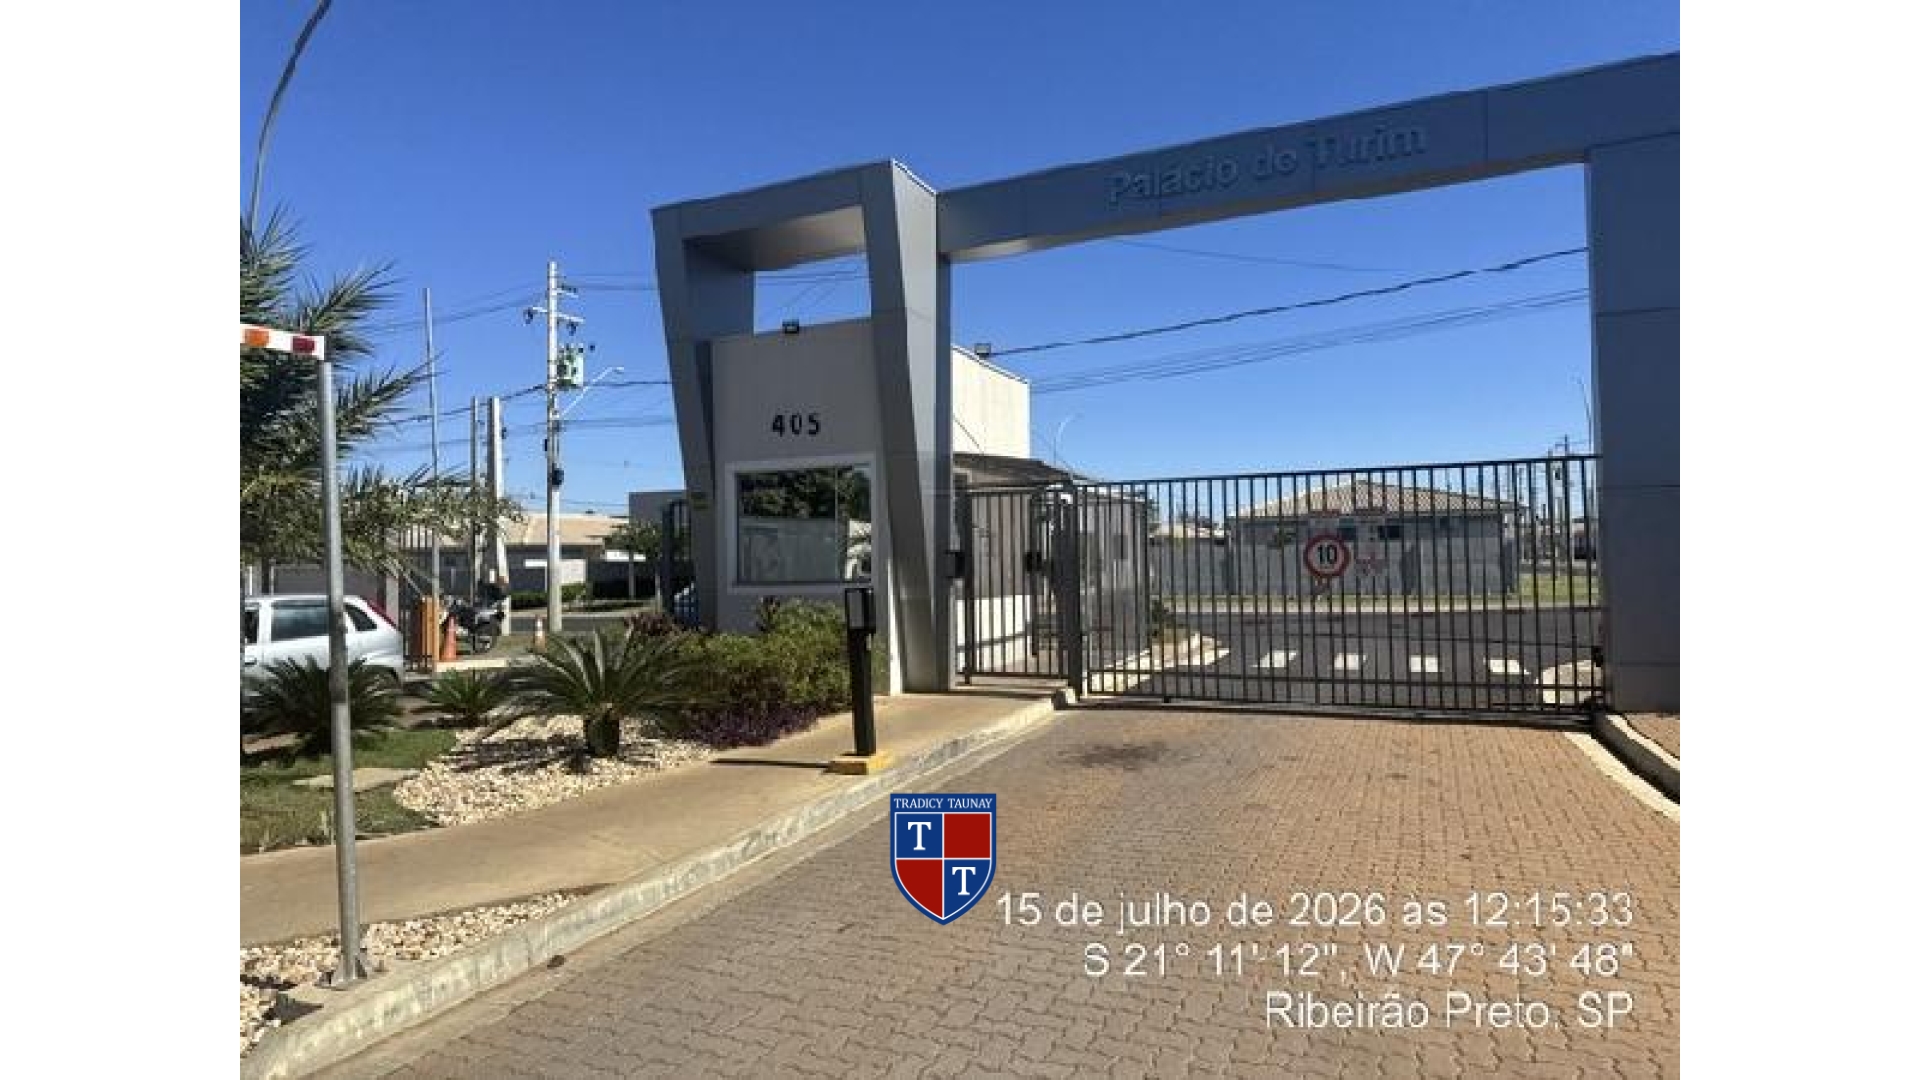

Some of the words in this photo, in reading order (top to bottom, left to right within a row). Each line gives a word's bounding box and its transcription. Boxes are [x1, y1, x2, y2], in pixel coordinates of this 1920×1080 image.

[1254, 145, 1298, 181] de
[1309, 125, 1427, 166] Turim
[771, 412, 821, 437] 405
[1317, 544, 1338, 565] 10
